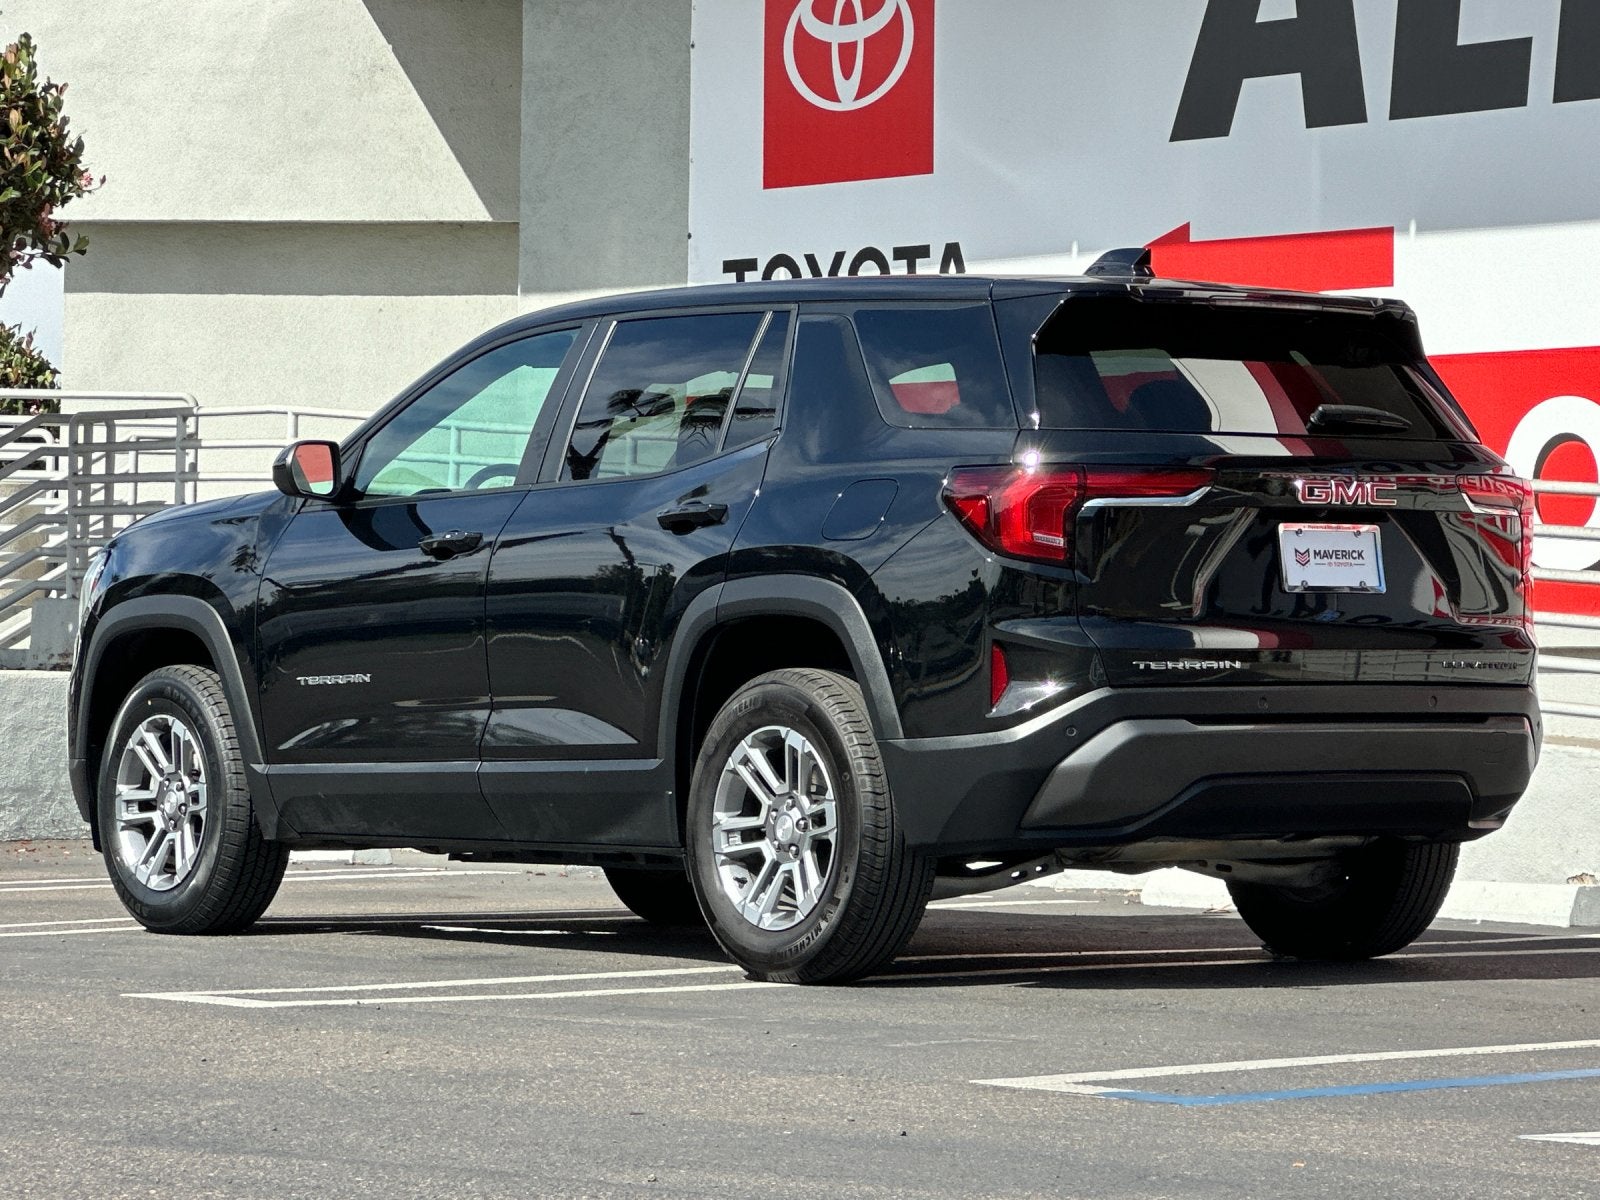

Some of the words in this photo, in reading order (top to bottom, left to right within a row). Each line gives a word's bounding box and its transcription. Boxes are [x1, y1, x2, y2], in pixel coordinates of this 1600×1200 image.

[1295, 479, 1397, 506] GMC
[1313, 549, 1365, 560] MAVERICK
[1132, 660, 1242, 670] TERRAIN
[296, 673, 372, 686] TERRAIN
